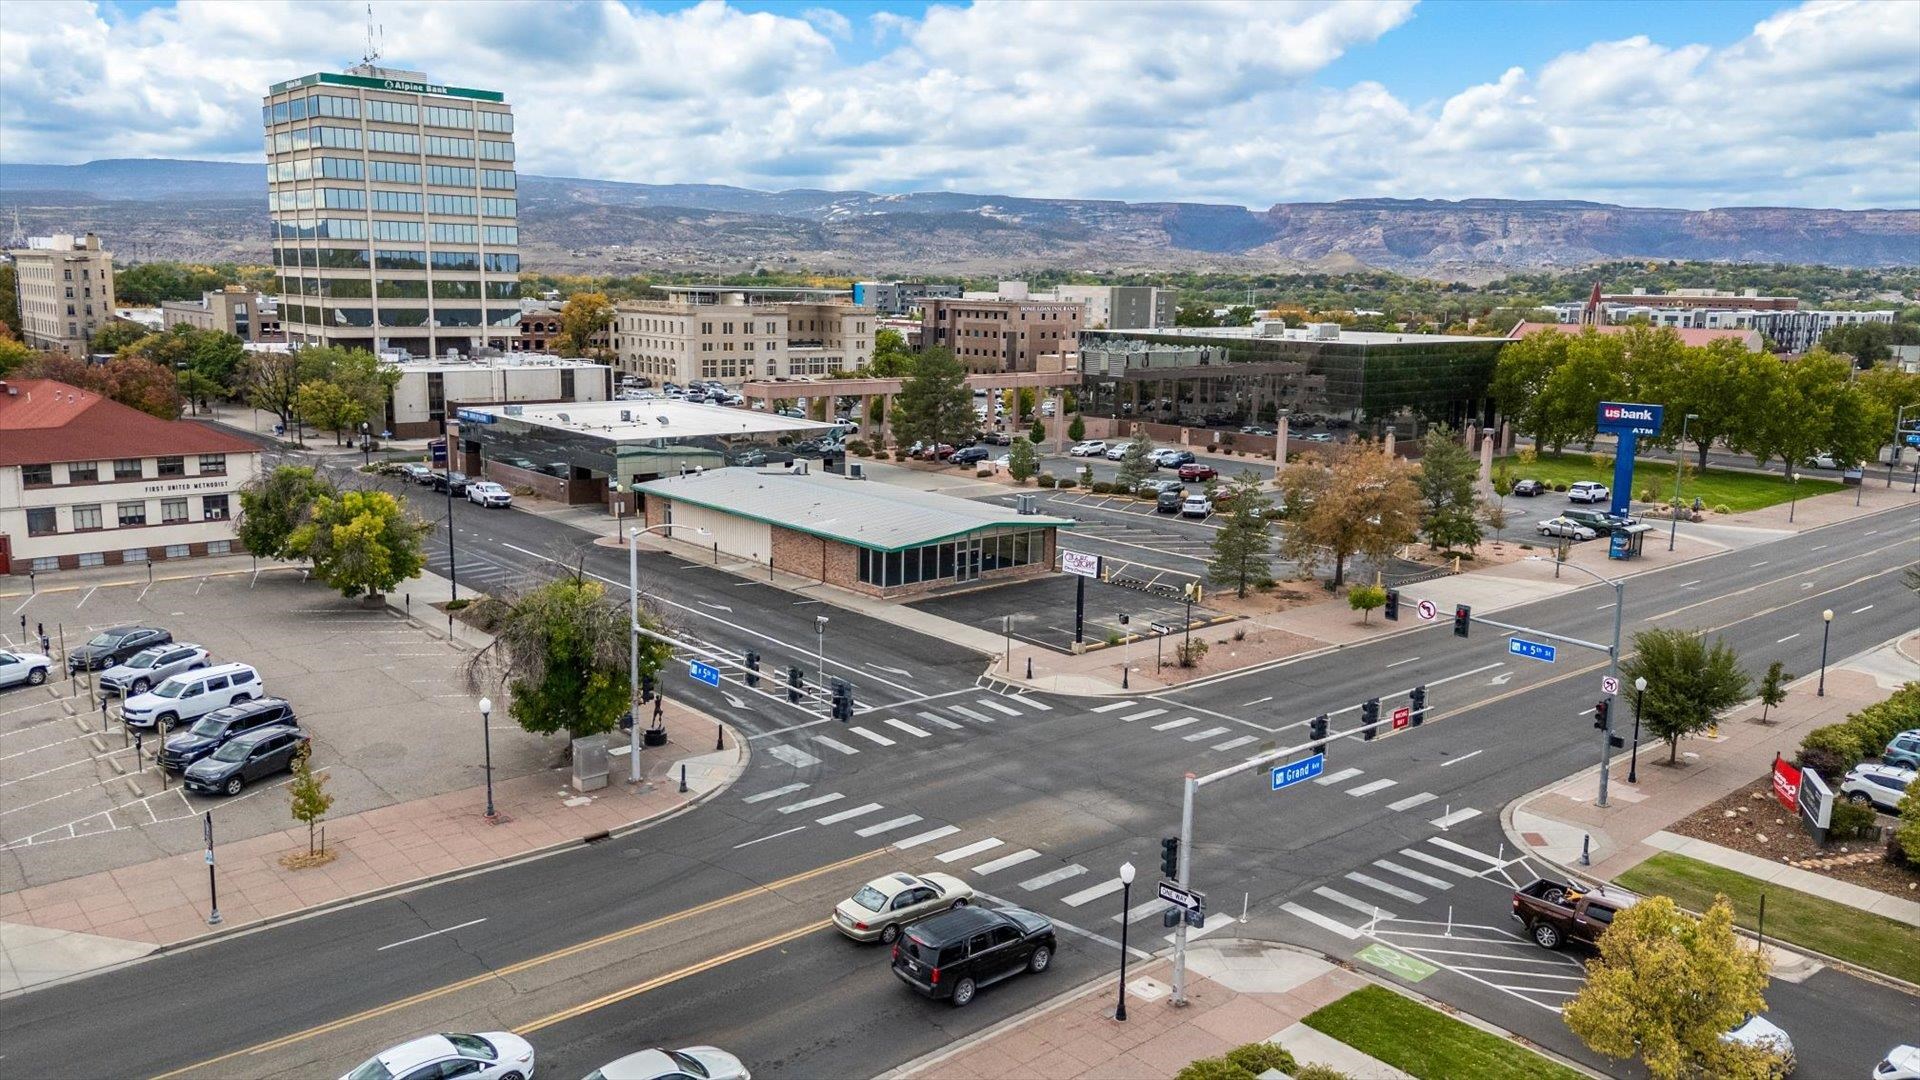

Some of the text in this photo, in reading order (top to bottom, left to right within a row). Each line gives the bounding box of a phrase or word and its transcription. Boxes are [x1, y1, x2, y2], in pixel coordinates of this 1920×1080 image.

[395, 81, 448, 94] Alpine Bank
[1605, 408, 1653, 420] usbank
[145, 481, 228, 493] FIRST UNITED METHODIST
[1530, 645, 1542, 655] 5th
[1287, 763, 1309, 781] Grand
[1162, 887, 1187, 902] ONE WAY
